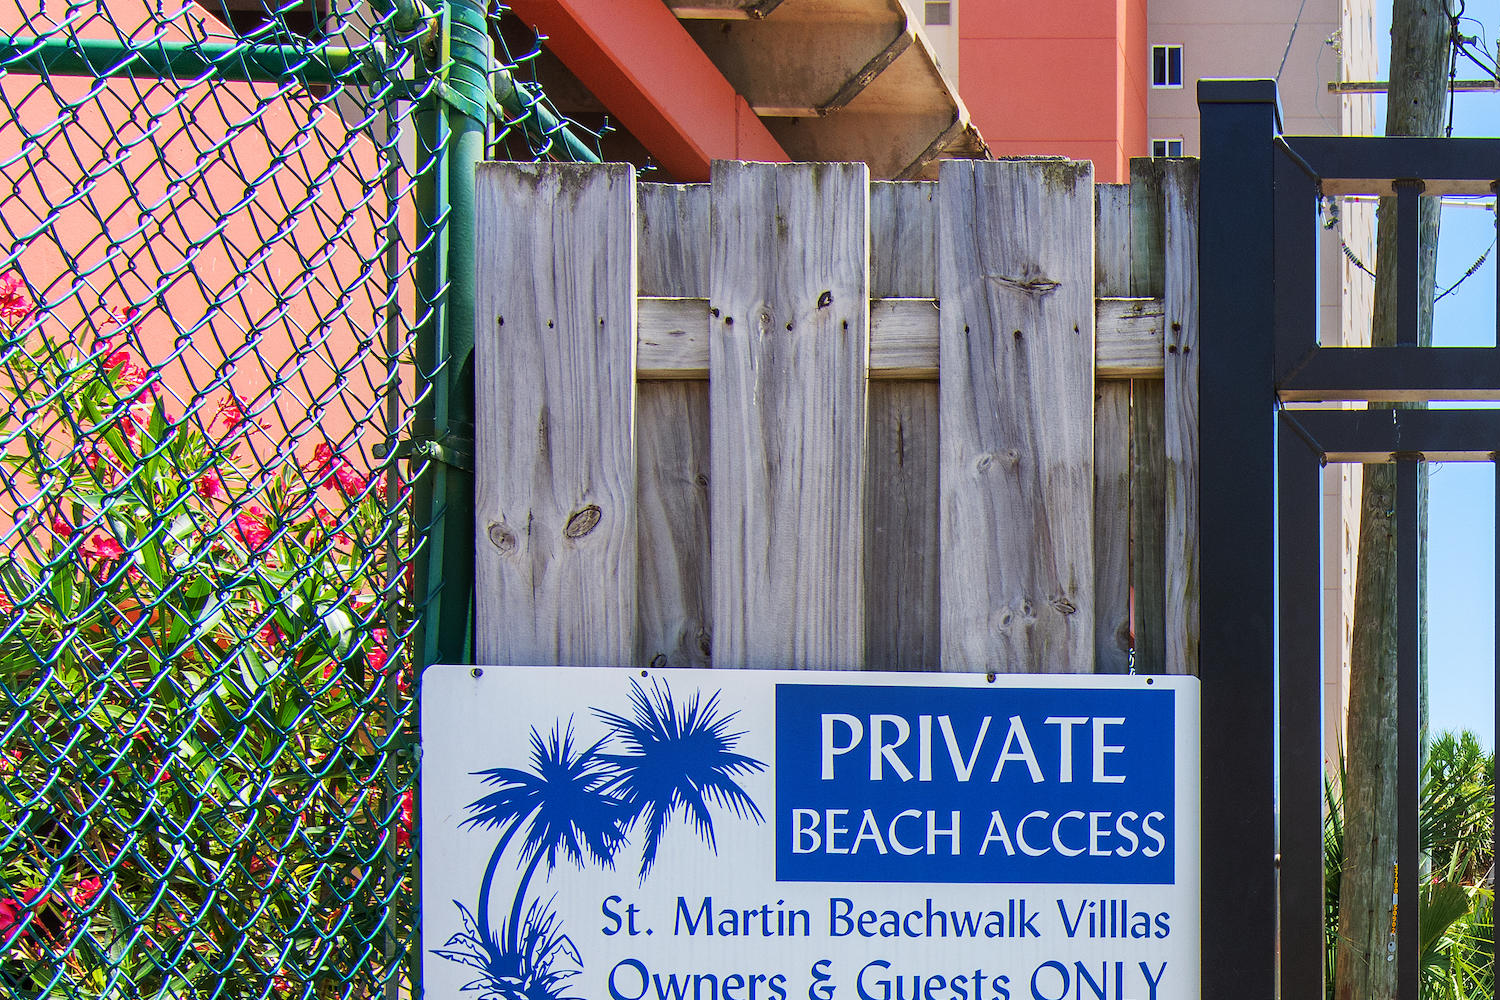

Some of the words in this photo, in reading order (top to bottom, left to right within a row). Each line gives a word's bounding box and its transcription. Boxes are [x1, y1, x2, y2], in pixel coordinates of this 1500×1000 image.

[821, 714, 1126, 783] PRIVATE
[792, 809, 960, 855] BEACH
[978, 811, 1165, 857] ACCESS
[601, 895, 653, 935] St.
[673, 897, 809, 936] Martin
[829, 898, 1040, 938] Beachwalk
[1056, 899, 1170, 939] Villlas
